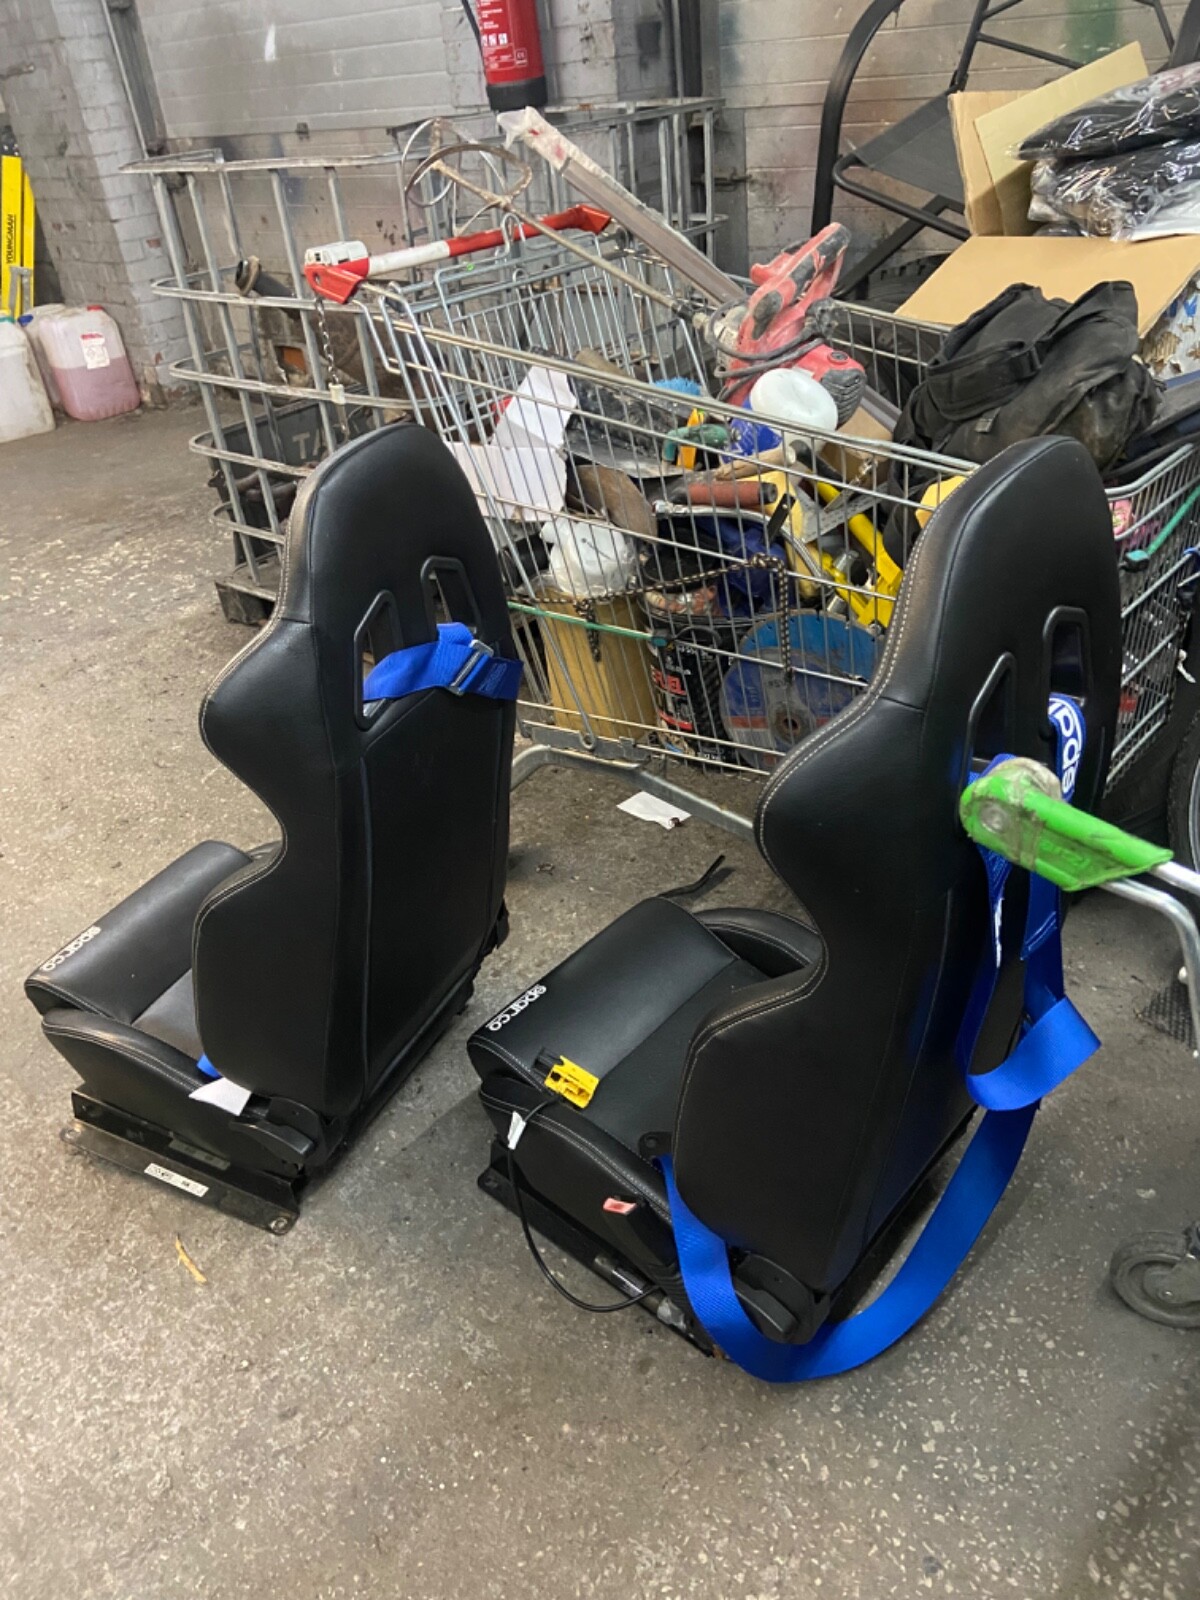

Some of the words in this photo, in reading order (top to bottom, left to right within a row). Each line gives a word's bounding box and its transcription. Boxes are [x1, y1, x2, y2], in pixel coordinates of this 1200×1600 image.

[6, 214, 14, 264] YOUNGMAN
[40, 926, 101, 972] sparco
[486, 985, 547, 1031] sparco
